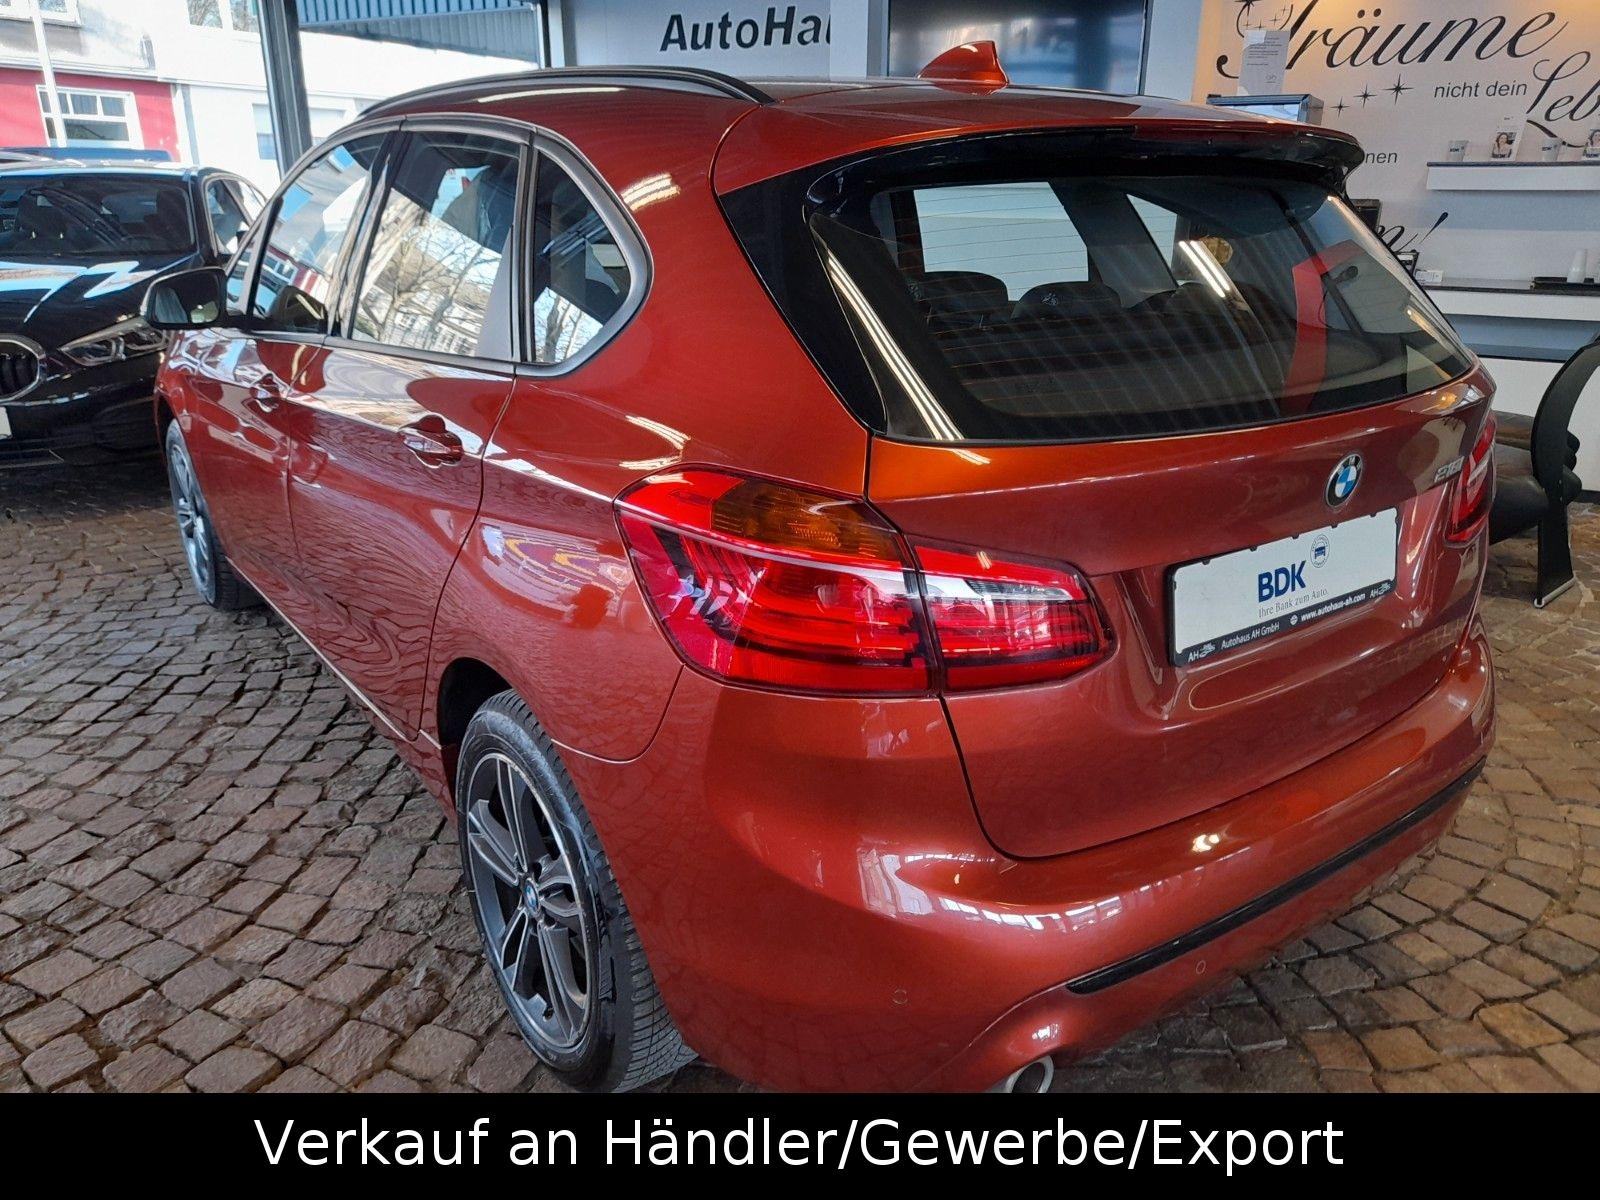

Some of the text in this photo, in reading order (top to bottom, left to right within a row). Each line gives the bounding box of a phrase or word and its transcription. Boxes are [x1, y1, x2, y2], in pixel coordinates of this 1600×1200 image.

[659, 5, 831, 52] AutoHa
[1434, 79, 1527, 99] nicht dein
[1365, 152, 1398, 164] nen
[1258, 560, 1306, 603] BDK
[1258, 606, 1274, 619] Ihre
[1275, 600, 1294, 613] Bank
[1295, 594, 1310, 605] zum
[1187, 650, 1200, 663] AH
[1221, 633, 1251, 650] Autohaus
[1251, 628, 1261, 639] AH
[1261, 621, 1280, 637] GmbH
